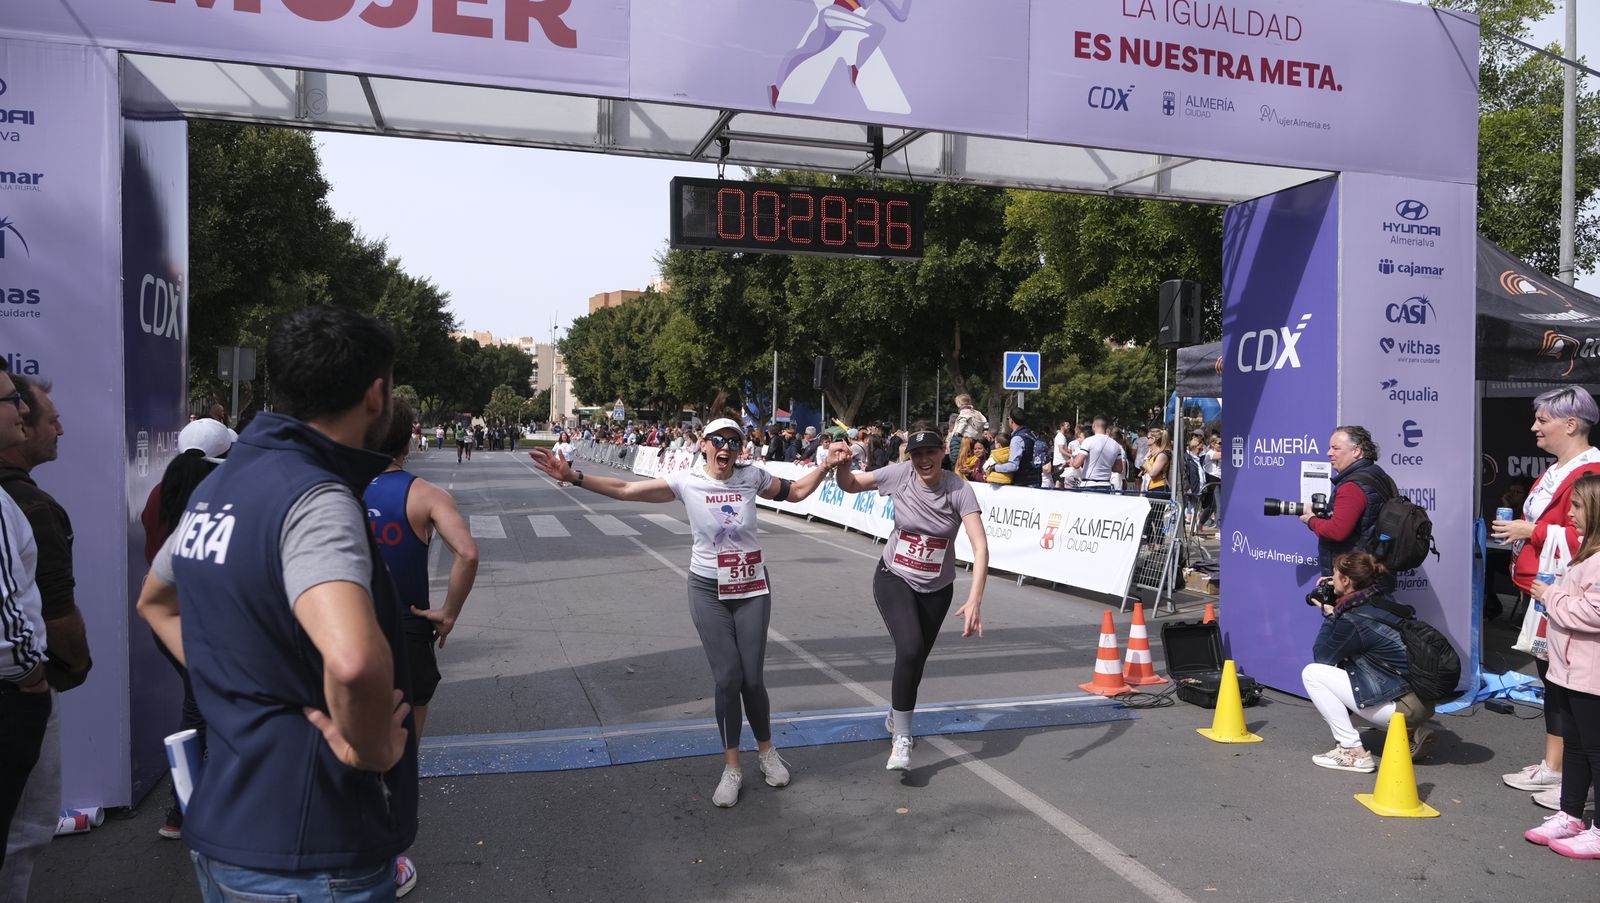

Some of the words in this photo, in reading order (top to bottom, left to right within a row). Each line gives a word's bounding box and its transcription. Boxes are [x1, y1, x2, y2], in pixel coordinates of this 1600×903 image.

[1122, 0, 1156, 21] LA
[1165, 0, 1302, 42] IGUALDAD
[1074, 30, 1112, 61] ES
[1119, 36, 1254, 82] NUESTRA
[1260, 57, 1344, 92] META.
[1087, 85, 1136, 112] CDX
[1185, 96, 1235, 112] ALMERÍA
[1185, 108, 1212, 119] CIUDAD
[717, 187, 912, 250] 00:28:36
[1383, 222, 1441, 236] HYUNDAI
[1398, 262, 1444, 277] cajamar
[139, 273, 181, 340] CDX
[1385, 303, 1427, 325] CASI
[1238, 320, 1307, 373] CDX
[1399, 340, 1441, 355] vithas
[1389, 387, 1439, 405] aqualia
[1254, 435, 1319, 454] ALMERÍA
[1254, 456, 1285, 467] CIUDAD
[1391, 453, 1423, 466] Clece
[706, 494, 742, 504] MUJER
[989, 506, 1041, 530] ALMERÍA
[986, 525, 1013, 540] CIUDAD
[1068, 517, 1134, 542] ALMERÍA
[908, 543, 935, 559] 517
[1066, 537, 1099, 554] CIUDAD
[730, 565, 756, 579] 516
[1398, 577, 1428, 592] njarón
